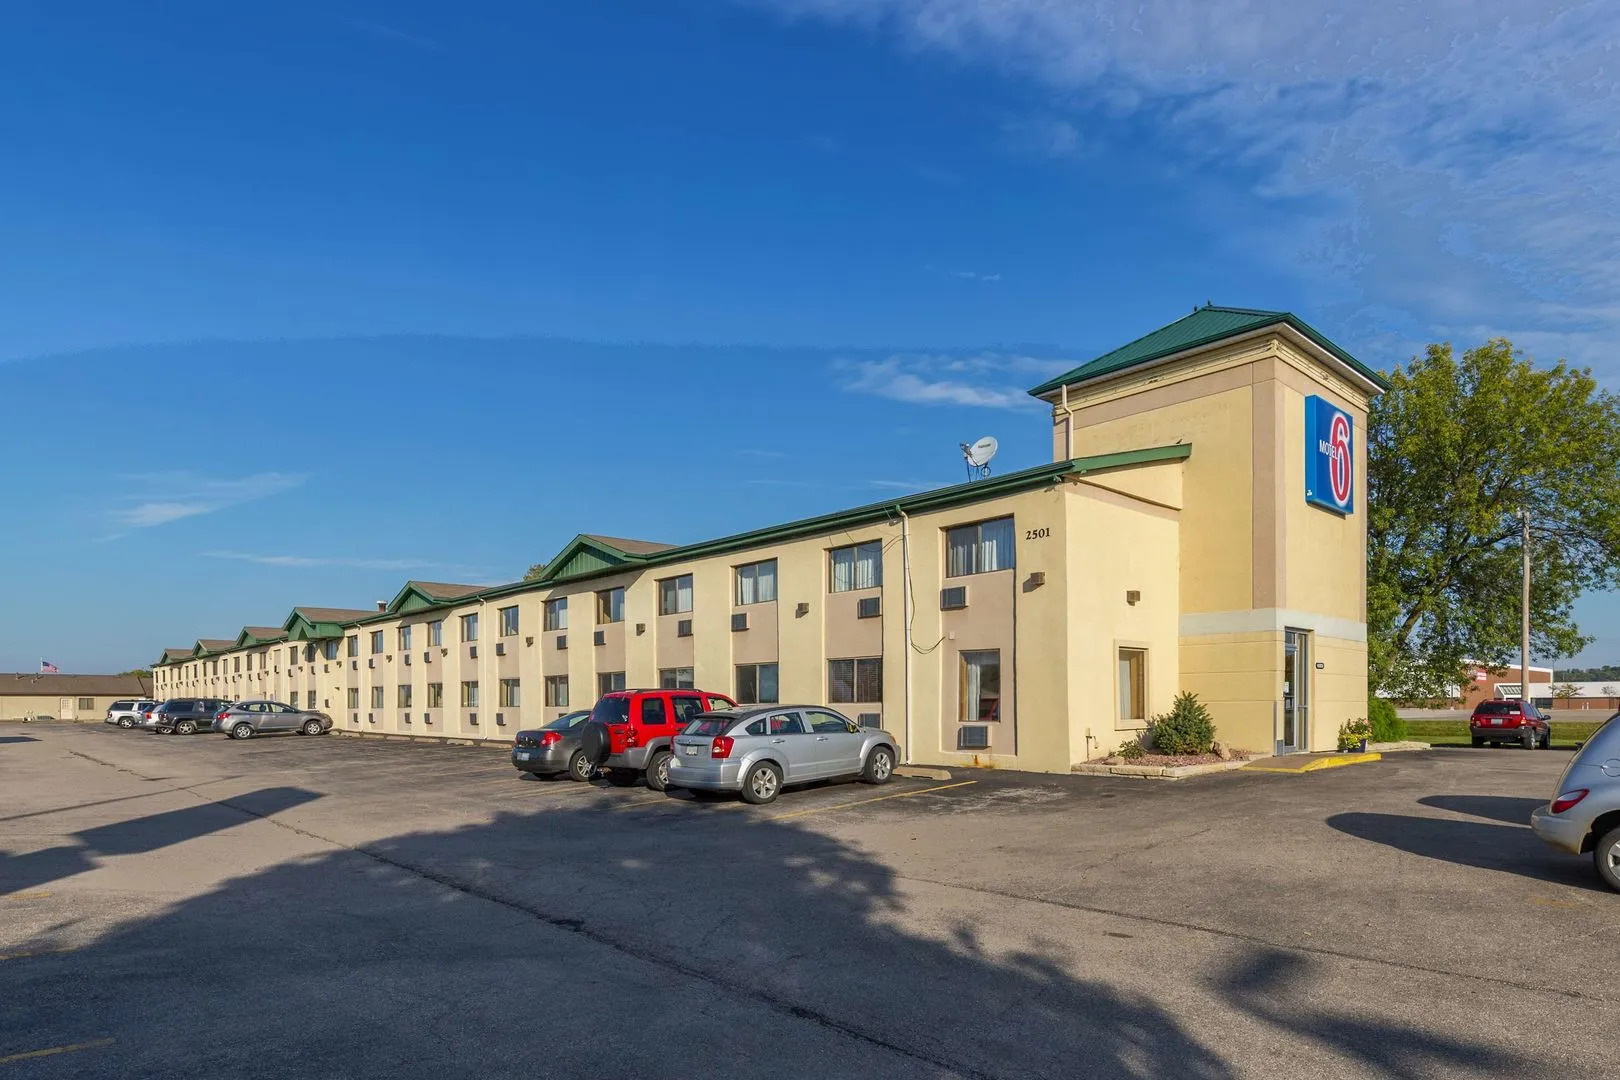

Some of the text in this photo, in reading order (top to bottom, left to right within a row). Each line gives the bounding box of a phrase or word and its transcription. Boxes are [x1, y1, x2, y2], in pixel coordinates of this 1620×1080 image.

[1319, 412, 1351, 506] MOTEL 6
[1025, 527, 1050, 540] 2501
